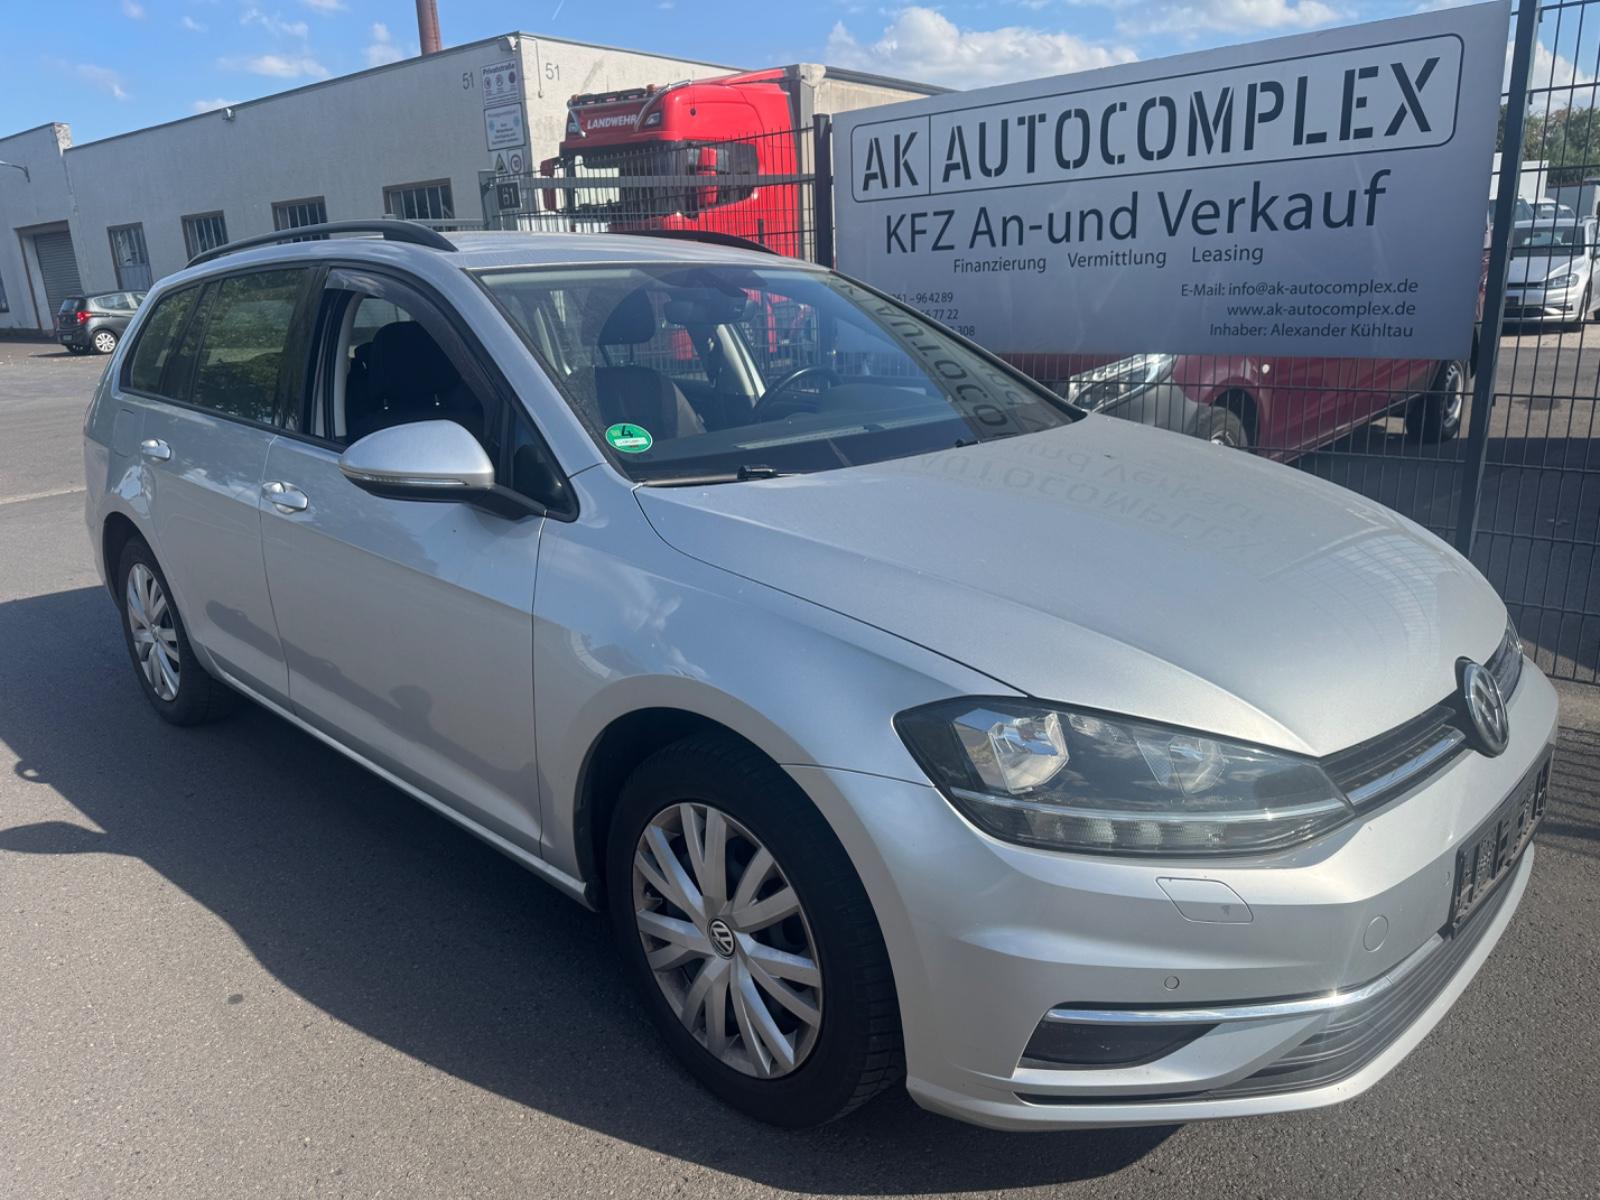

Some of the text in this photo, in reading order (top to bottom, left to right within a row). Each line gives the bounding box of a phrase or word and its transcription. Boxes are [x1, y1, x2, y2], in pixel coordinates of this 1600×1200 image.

[545, 62, 560, 80] 51
[462, 72, 474, 90] 51
[587, 114, 638, 129] LANDWEHR
[863, 57, 1441, 191] AK AUTOCOMPLEX
[886, 168, 1392, 255] KFZ An-und Verkauf
[953, 244, 1265, 274] Finanzierung Vermittlung Leasing
[1181, 278, 1419, 297] E-Mail: info@ak-autocomplex.de
[1227, 300, 1417, 318] www.ak-autocomplex.de
[1210, 322, 1414, 338] Inhaber: Alexander Kühltau
[621, 425, 634, 438] 4
